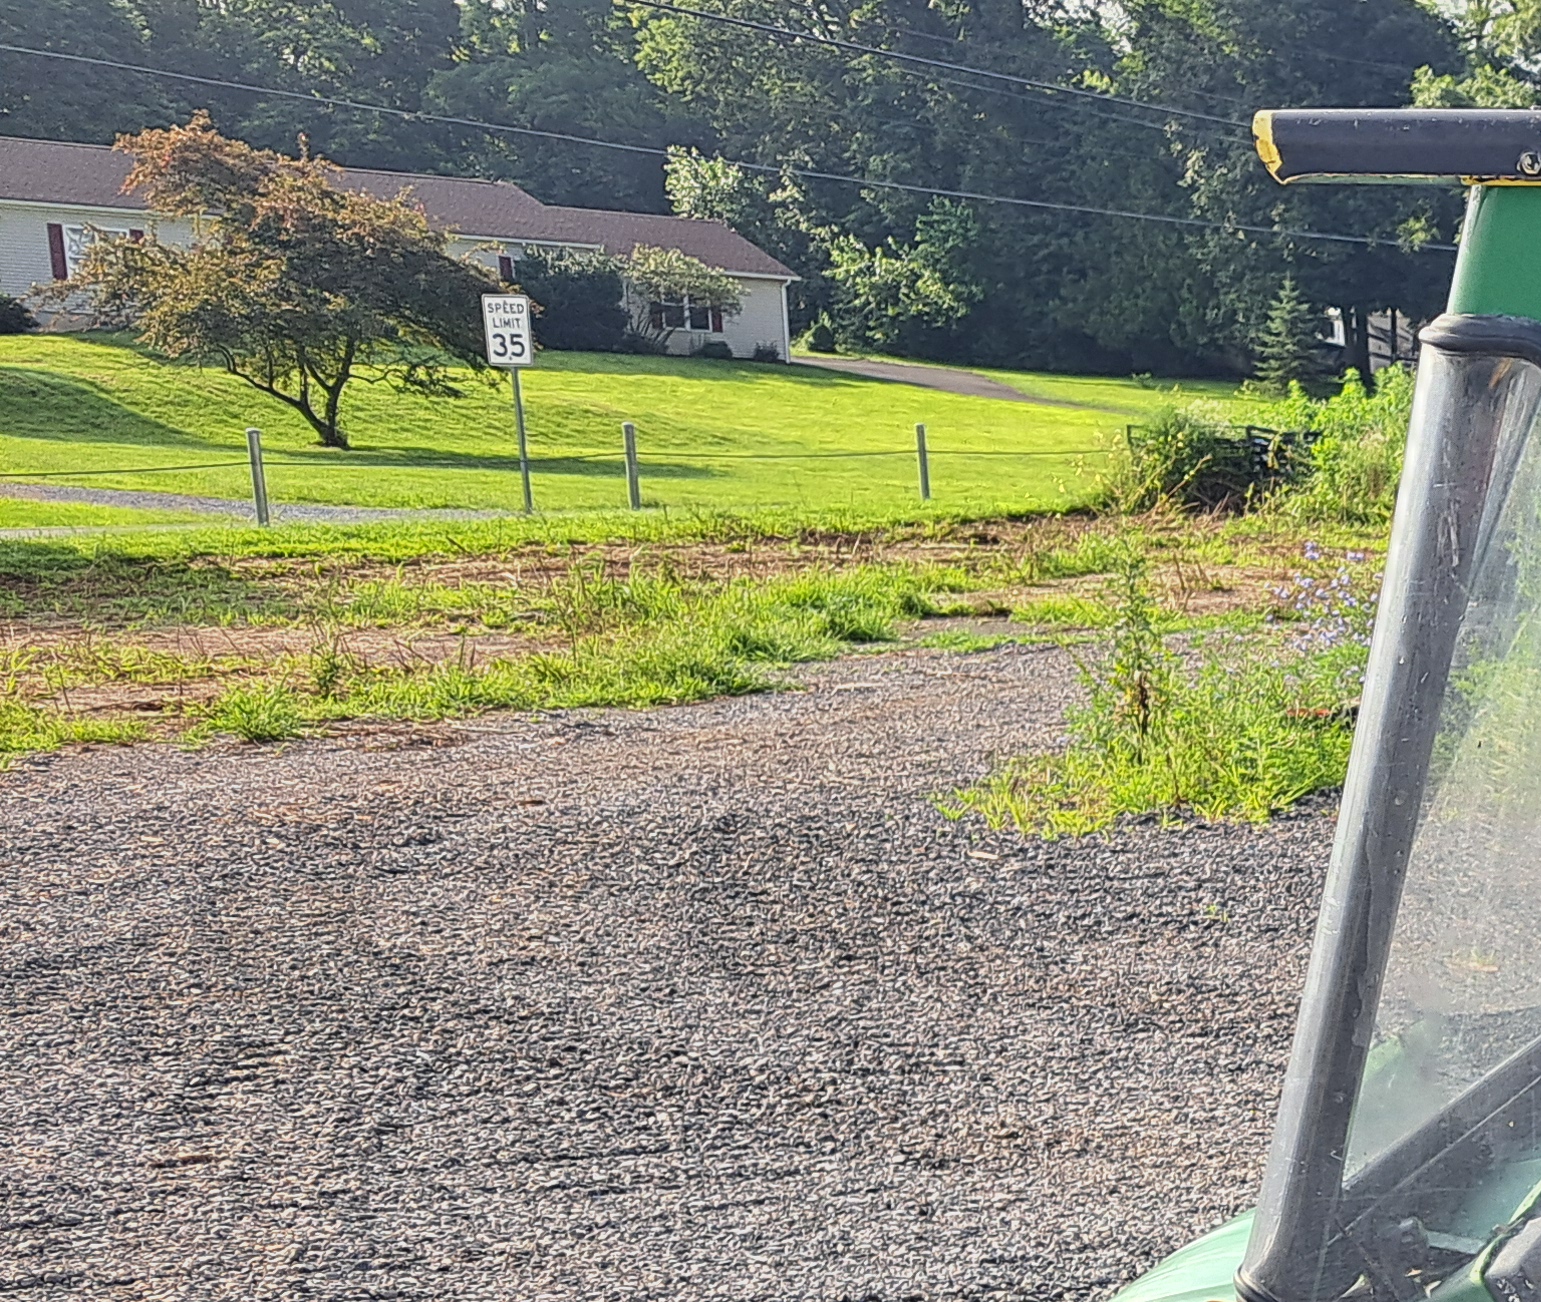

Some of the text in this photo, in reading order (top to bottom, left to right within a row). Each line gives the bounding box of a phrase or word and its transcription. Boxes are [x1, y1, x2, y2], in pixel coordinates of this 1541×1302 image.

[487, 302, 525, 314] SPEED
[492, 317, 521, 328] LIMIT
[492, 333, 525, 357] 35
